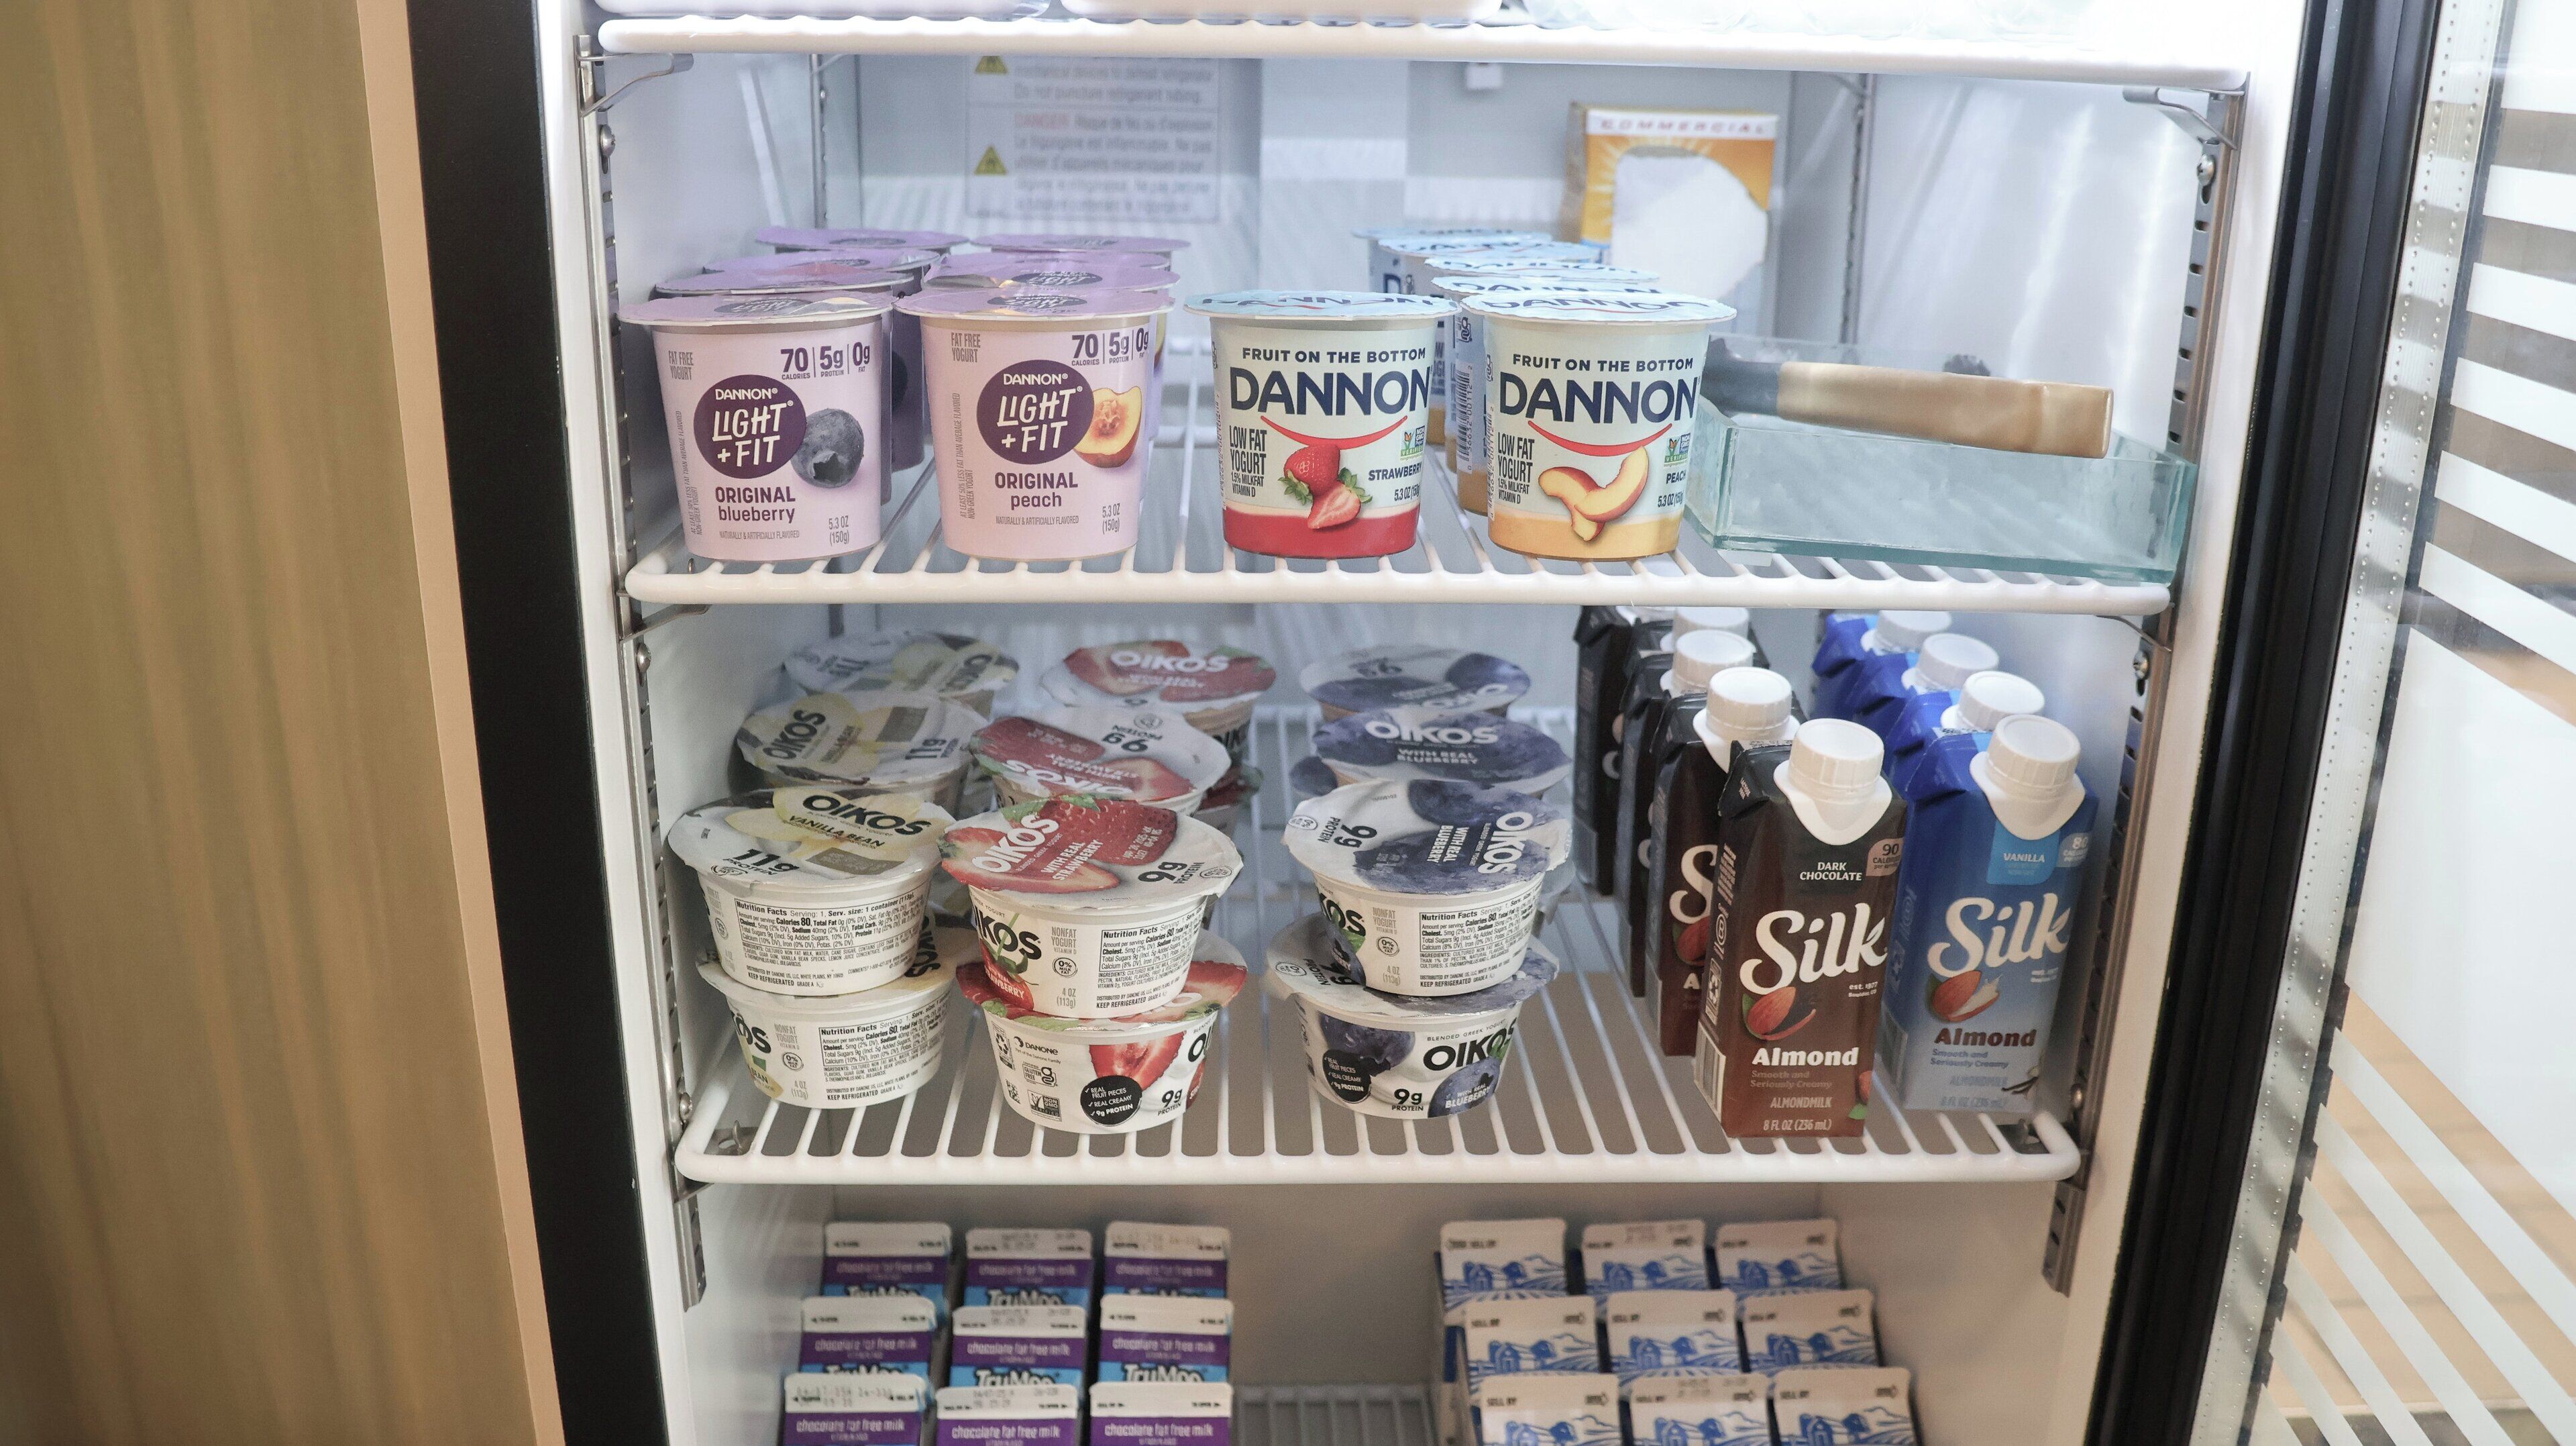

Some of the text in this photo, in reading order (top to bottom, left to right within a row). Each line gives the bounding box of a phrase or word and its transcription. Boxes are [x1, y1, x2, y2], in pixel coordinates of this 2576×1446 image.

[951, 332, 981, 348] FAT FREE
[1072, 327, 1148, 358] 70 5g 0g
[669, 351, 694, 366] FAT FREE
[781, 342, 870, 372] 70 5g 0g
[952, 348, 977, 363] YOGURT
[1109, 356, 1129, 364] PROTEIN
[1242, 348, 1426, 364] FRUIT ON THE BOTTOM
[1513, 354, 1693, 372] FRUIT ON THE BOTTOM
[671, 366, 692, 380] YOGURT
[1004, 373, 1061, 385] DANNON
[715, 389, 771, 400] DANNON
[1230, 366, 1430, 416] DANNON
[1500, 372, 1698, 423] DANNON
[997, 389, 1076, 427] LIGHT
[712, 403, 787, 442] LIGHT
[1229, 425, 1267, 452] LOW FAT
[1497, 431, 1535, 459] LOW FAT
[1230, 450, 1267, 475] YOGURT
[1368, 462, 1421, 480] STRAWBERRY
[1498, 456, 1533, 484] YOGURT
[995, 472, 1078, 489] ORIGINAL
[1241, 474, 1264, 487] MILKFAT
[1666, 470, 1686, 484] PEACH
[715, 486, 796, 503] ORIGINAL
[1232, 484, 1256, 497] VITAMIN D
[1395, 486, 1410, 501] 5.3 OZ
[1507, 480, 1529, 495] MILKFAT
[1011, 492, 1062, 511] peach
[1498, 490, 1521, 504] VITAMIN D
[1658, 493, 1674, 507] 5.3 OZ
[718, 506, 795, 523] blueberry
[1102, 503, 1120, 518] 5.3 OZ
[828, 515, 849, 530] 5.3 OZ
[996, 515, 1020, 525] NATURALLY
[1056, 515, 1079, 524] FLAVORED
[1102, 518, 1120, 535] (150g)
[829, 530, 849, 546] (150g)
[1110, 650, 1229, 673] OIKOS
[761, 709, 826, 760] OIKOS
[1364, 721, 1499, 745] OIKOS
[802, 794, 932, 835] OIKOS
[788, 815, 885, 848] VANILLA BEAN
[1318, 817, 1341, 843] PROTEIN
[1334, 825, 1377, 849] 9g
[972, 814, 1059, 872] OIKOS
[1426, 825, 1454, 863] BLUEBERRY
[1442, 827, 1470, 862] WITH REAL
[1478, 812, 1533, 874] OIKOS
[1882, 843, 1898, 856] 90
[733, 848, 800, 872] 11g
[1040, 841, 1087, 873] WITH REAL
[1052, 839, 1105, 880] STRAWBERRY
[2002, 853, 2045, 863] VANILLA
[722, 858, 777, 875] PROTEIN
[1138, 861, 1187, 882] 9g
[1173, 862, 1205, 884] PROTEIN
[1817, 862, 1846, 872] DARK
[1799, 871, 1862, 882] CHOCOLATE
[737, 900, 765, 913] Nutrition
[767, 907, 787, 916] Facts
[1373, 907, 1395, 920] NONFAT
[973, 905, 1042, 960] IKOS
[1051, 927, 1077, 938] NONFAT
[1139, 927, 1158, 935] Facts
[1146, 934, 1166, 943] Calories
[1927, 892, 2071, 978] Silk
[1051, 936, 1077, 948] YOGURT
[1739, 902, 1888, 995] Silk
[748, 972, 758, 980] KEEP
[759, 975, 794, 986] REFRIGERATED
[1062, 988, 1076, 997] 4 OZ
[1057, 996, 1075, 1009] (113g)
[1111, 998, 1146, 1006] REFRIGERATED
[1463, 1029, 1483, 1037] GREEK
[1934, 1028, 2037, 1047] Almond
[1752, 1047, 1859, 1066] Almond
[1092, 1088, 1127, 1099] FRUIT PIECES
[1109, 1095, 1132, 1104] CREAMY
[1162, 1089, 1183, 1107] 9g
[1394, 1088, 1422, 1105] 9g
[1445, 1085, 1491, 1108] BLUEBERRY
[1106, 1104, 1133, 1115] PROTEIN
[1158, 1102, 1181, 1116] PROTEIN
[1770, 1097, 1833, 1108] ALMONDMILK
[1782, 1120, 1792, 1131] OZ
[1170, 1425, 1191, 1436] free
[1192, 1425, 1213, 1436] milk
